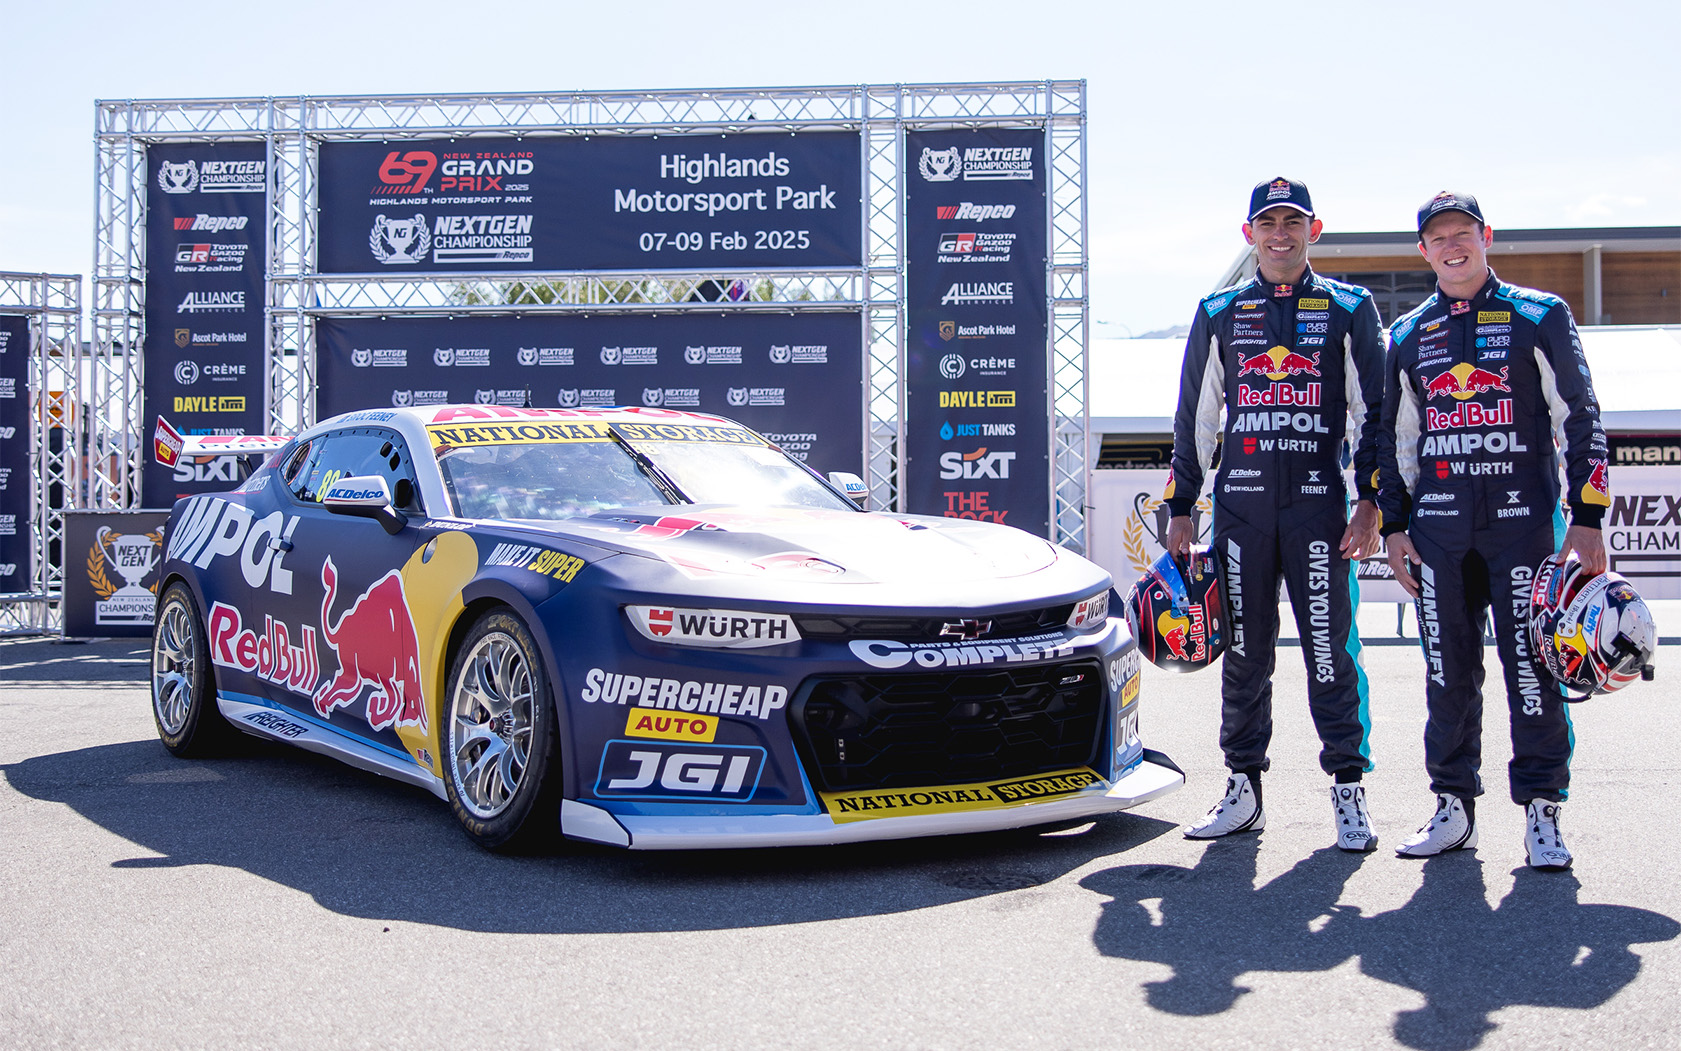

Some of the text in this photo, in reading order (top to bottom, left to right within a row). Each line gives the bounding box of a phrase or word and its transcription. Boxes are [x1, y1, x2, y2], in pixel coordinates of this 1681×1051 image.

[964, 148, 1033, 161] NEXTGEN
[201, 161, 266, 174] NEXTGEN
[441, 159, 534, 176] GRAND
[660, 151, 790, 185] Highlands
[964, 161, 1032, 170] CHAMPIONSHIP
[201, 174, 266, 183] CHAMPIONSHIP
[378, 151, 438, 194] 69
[440, 176, 529, 192] PRIX 2025
[369, 196, 533, 206] HIGHLANDS MOTORSPORT PARK
[614, 184, 837, 217] Motorsport Park
[955, 202, 1016, 222] Repco
[191, 213, 249, 233] Repco
[433, 215, 534, 236] NEXTGEN
[433, 235, 533, 248] CHAMPIONSHIP
[639, 230, 811, 252] 07-09 Feb 2025
[939, 240, 973, 252] GR
[502, 250, 530, 260] Repco
[974, 245, 1010, 253] Racing
[176, 251, 210, 263] GR
[209, 255, 244, 264] Racing
[937, 254, 1010, 263] New Zealand
[174, 264, 243, 273] New Zealand
[941, 282, 1013, 305] ALLIANCE
[1336, 291, 1358, 305] OMP
[177, 291, 246, 313] ALLIANCE
[1207, 296, 1227, 310] OMP
[1520, 304, 1543, 315] OMP
[957, 324, 1016, 336] Ascot Park Hotel
[1233, 329, 1264, 337] Partners
[1395, 320, 1412, 337] OMP
[192, 333, 247, 343] Ascot Park Hotel
[1299, 337, 1325, 345] JGI
[373, 349, 408, 357] NEXTGEN
[539, 347, 575, 356] NEXTGEN
[706, 346, 742, 354] NEXTGEN
[791, 345, 828, 353] NEXTGEN
[1418, 344, 1436, 352] Shaw
[1418, 348, 1448, 360] Partners
[1479, 351, 1507, 360] JGI
[203, 363, 247, 375] CRÈME
[970, 356, 1016, 369] CRÈME
[413, 390, 448, 398] NEXTGEN
[580, 389, 615, 397] NEXTGEN
[664, 388, 700, 396] NEXTGEN
[749, 388, 785, 396] NEXTGEN
[173, 397, 217, 412] DAYLE
[939, 391, 985, 408] DAYLE
[1231, 412, 1330, 434] AMPOL
[430, 423, 754, 445] NATIONAL STORAGE
[956, 424, 1016, 436] JUST TANKS
[761, 433, 817, 441] TOYOTA
[1421, 431, 1528, 458] AMPOL
[1228, 469, 1262, 477] ACDelco
[327, 488, 384, 499] ACDelco
[1301, 485, 1328, 495] FEENEY
[943, 492, 989, 511] THE
[1420, 492, 1455, 502] ACDelco
[1497, 506, 1530, 519] BROWN
[118, 545, 151, 556] NEXT
[121, 556, 147, 567] GEN
[484, 542, 586, 584] MAKE IT SUPER
[100, 604, 155, 612] CHAMPIONS
[1308, 540, 1335, 684] GIVES YOU WINGS
[679, 614, 788, 639] WÜRTH
[1583, 604, 1602, 636] Thrifty
[910, 641, 950, 649] PARTS
[961, 636, 1018, 646] EQUIPMENT
[1018, 631, 1064, 643] SOLUTIONS
[1421, 579, 1446, 688] AMPLIFY
[1510, 565, 1543, 717] GIVES WINGS
[581, 667, 788, 720] SUPERCHEAP
[1123, 675, 1140, 701] AUTO
[635, 715, 708, 735] AUTO
[607, 750, 751, 793] JGI
[835, 771, 1102, 813] NATIONAL STORAGE
